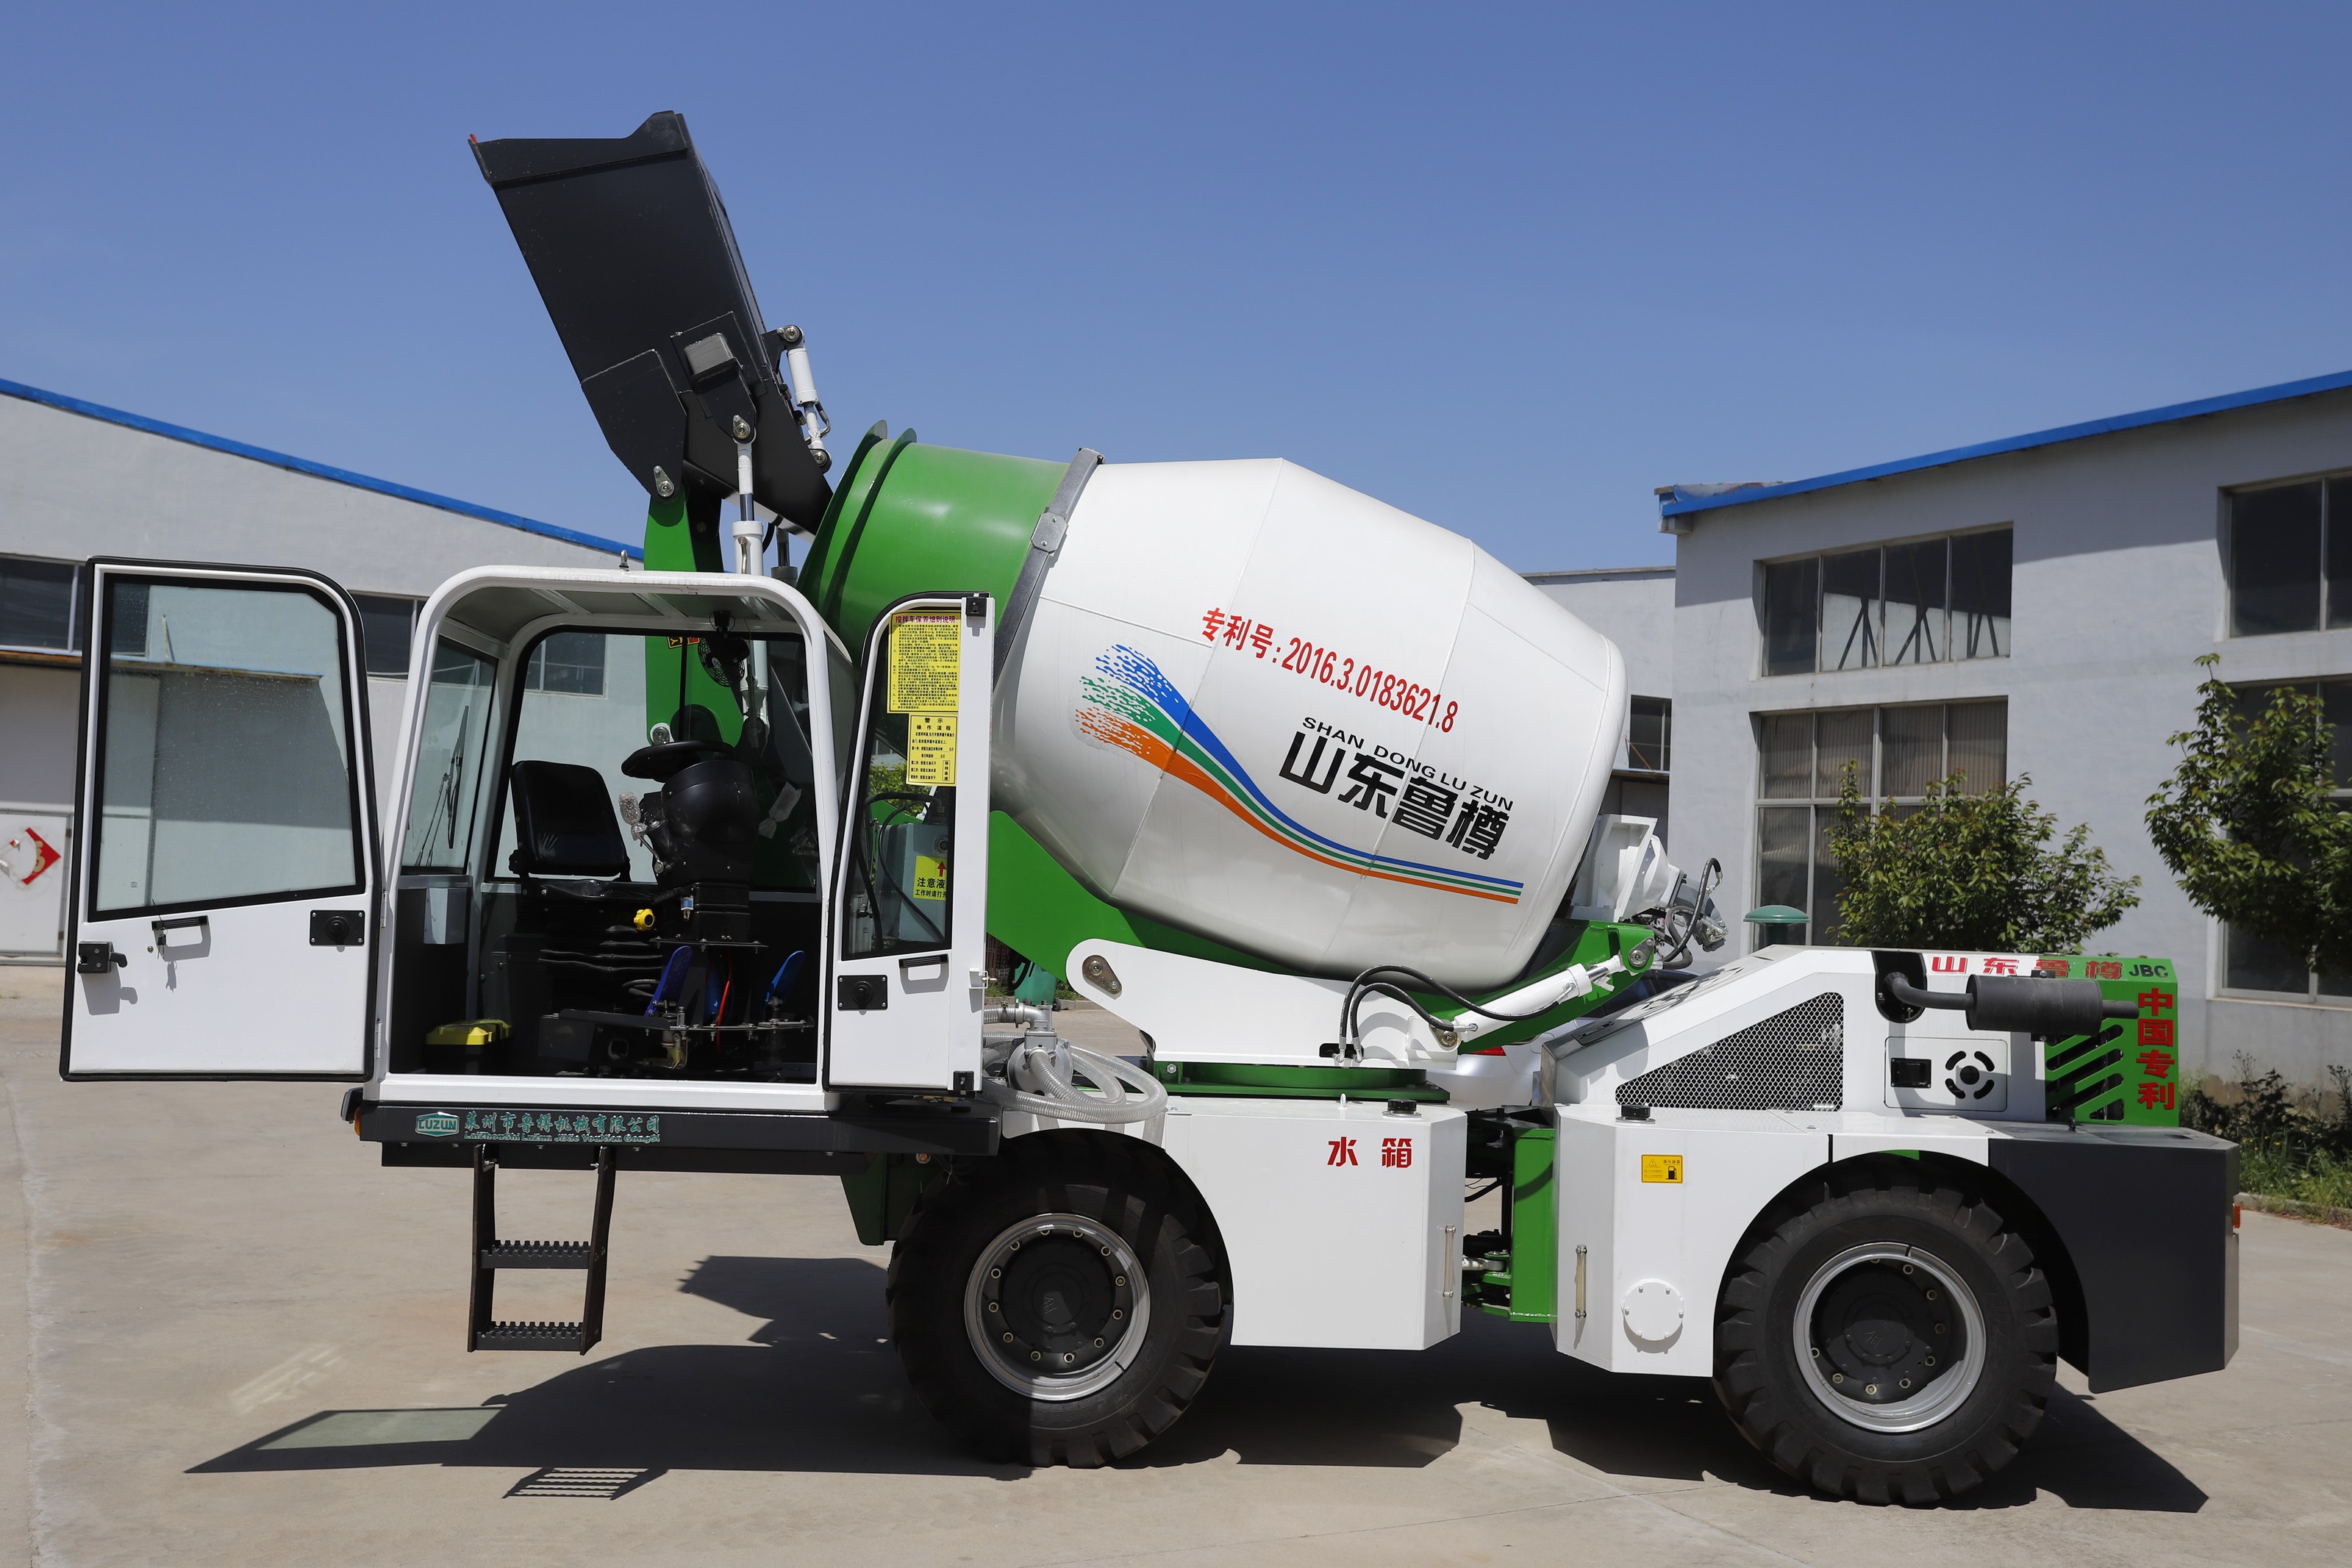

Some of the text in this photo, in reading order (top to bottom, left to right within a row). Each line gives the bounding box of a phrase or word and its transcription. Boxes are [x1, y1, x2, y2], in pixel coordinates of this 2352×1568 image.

[1279, 731, 1510, 860] 山东鲁樽
[1303, 717, 1513, 812] SHAN DONG LU ZUN
[2128, 964, 2168, 978] JBC
[2136, 987, 2176, 1111] 中国专利
[418, 1119, 457, 1131] LUZUN
[1327, 1136, 1412, 1168] 水箱
